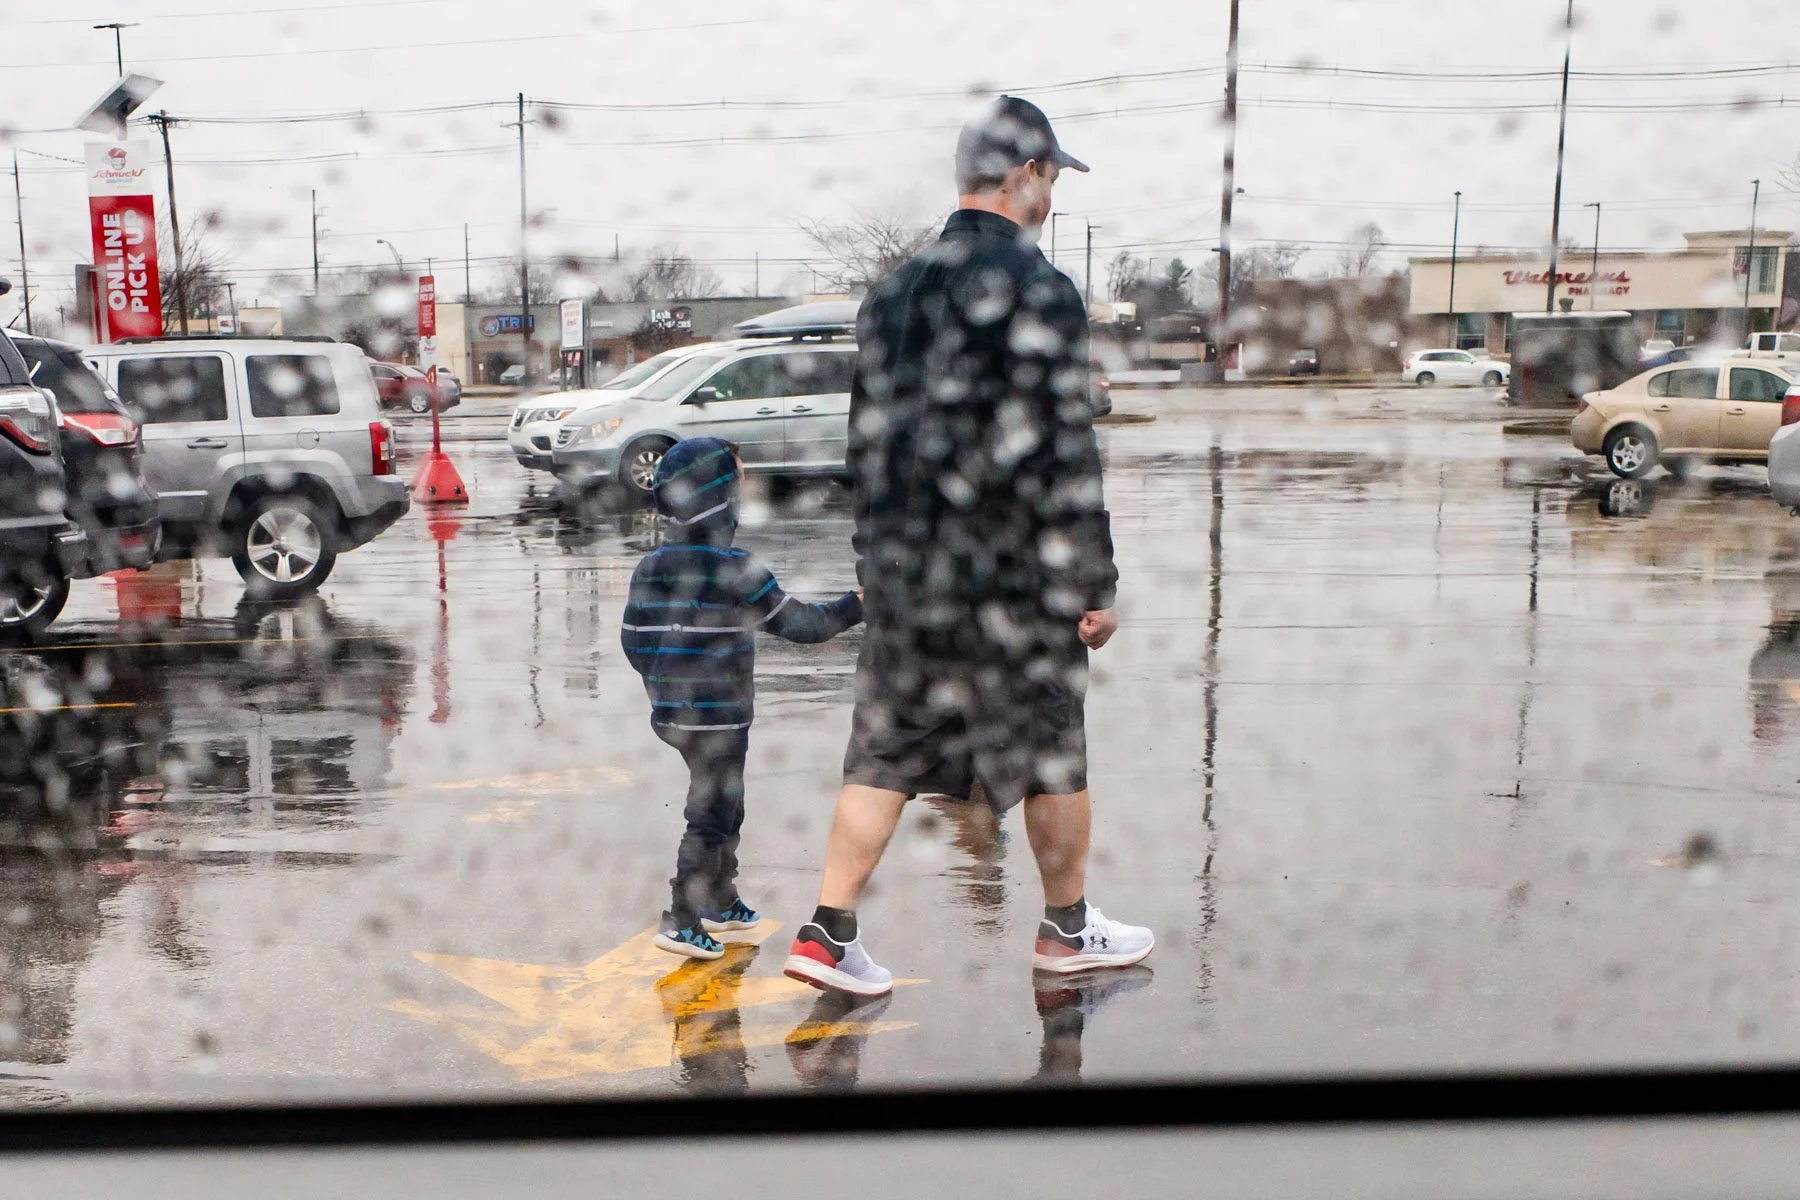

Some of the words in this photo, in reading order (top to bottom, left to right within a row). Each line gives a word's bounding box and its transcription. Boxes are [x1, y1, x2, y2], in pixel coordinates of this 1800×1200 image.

[124, 209, 145, 246] UP
[102, 213, 128, 311] ONLINE
[127, 252, 149, 313] PICK
[1567, 286, 1630, 296] PHAACY
